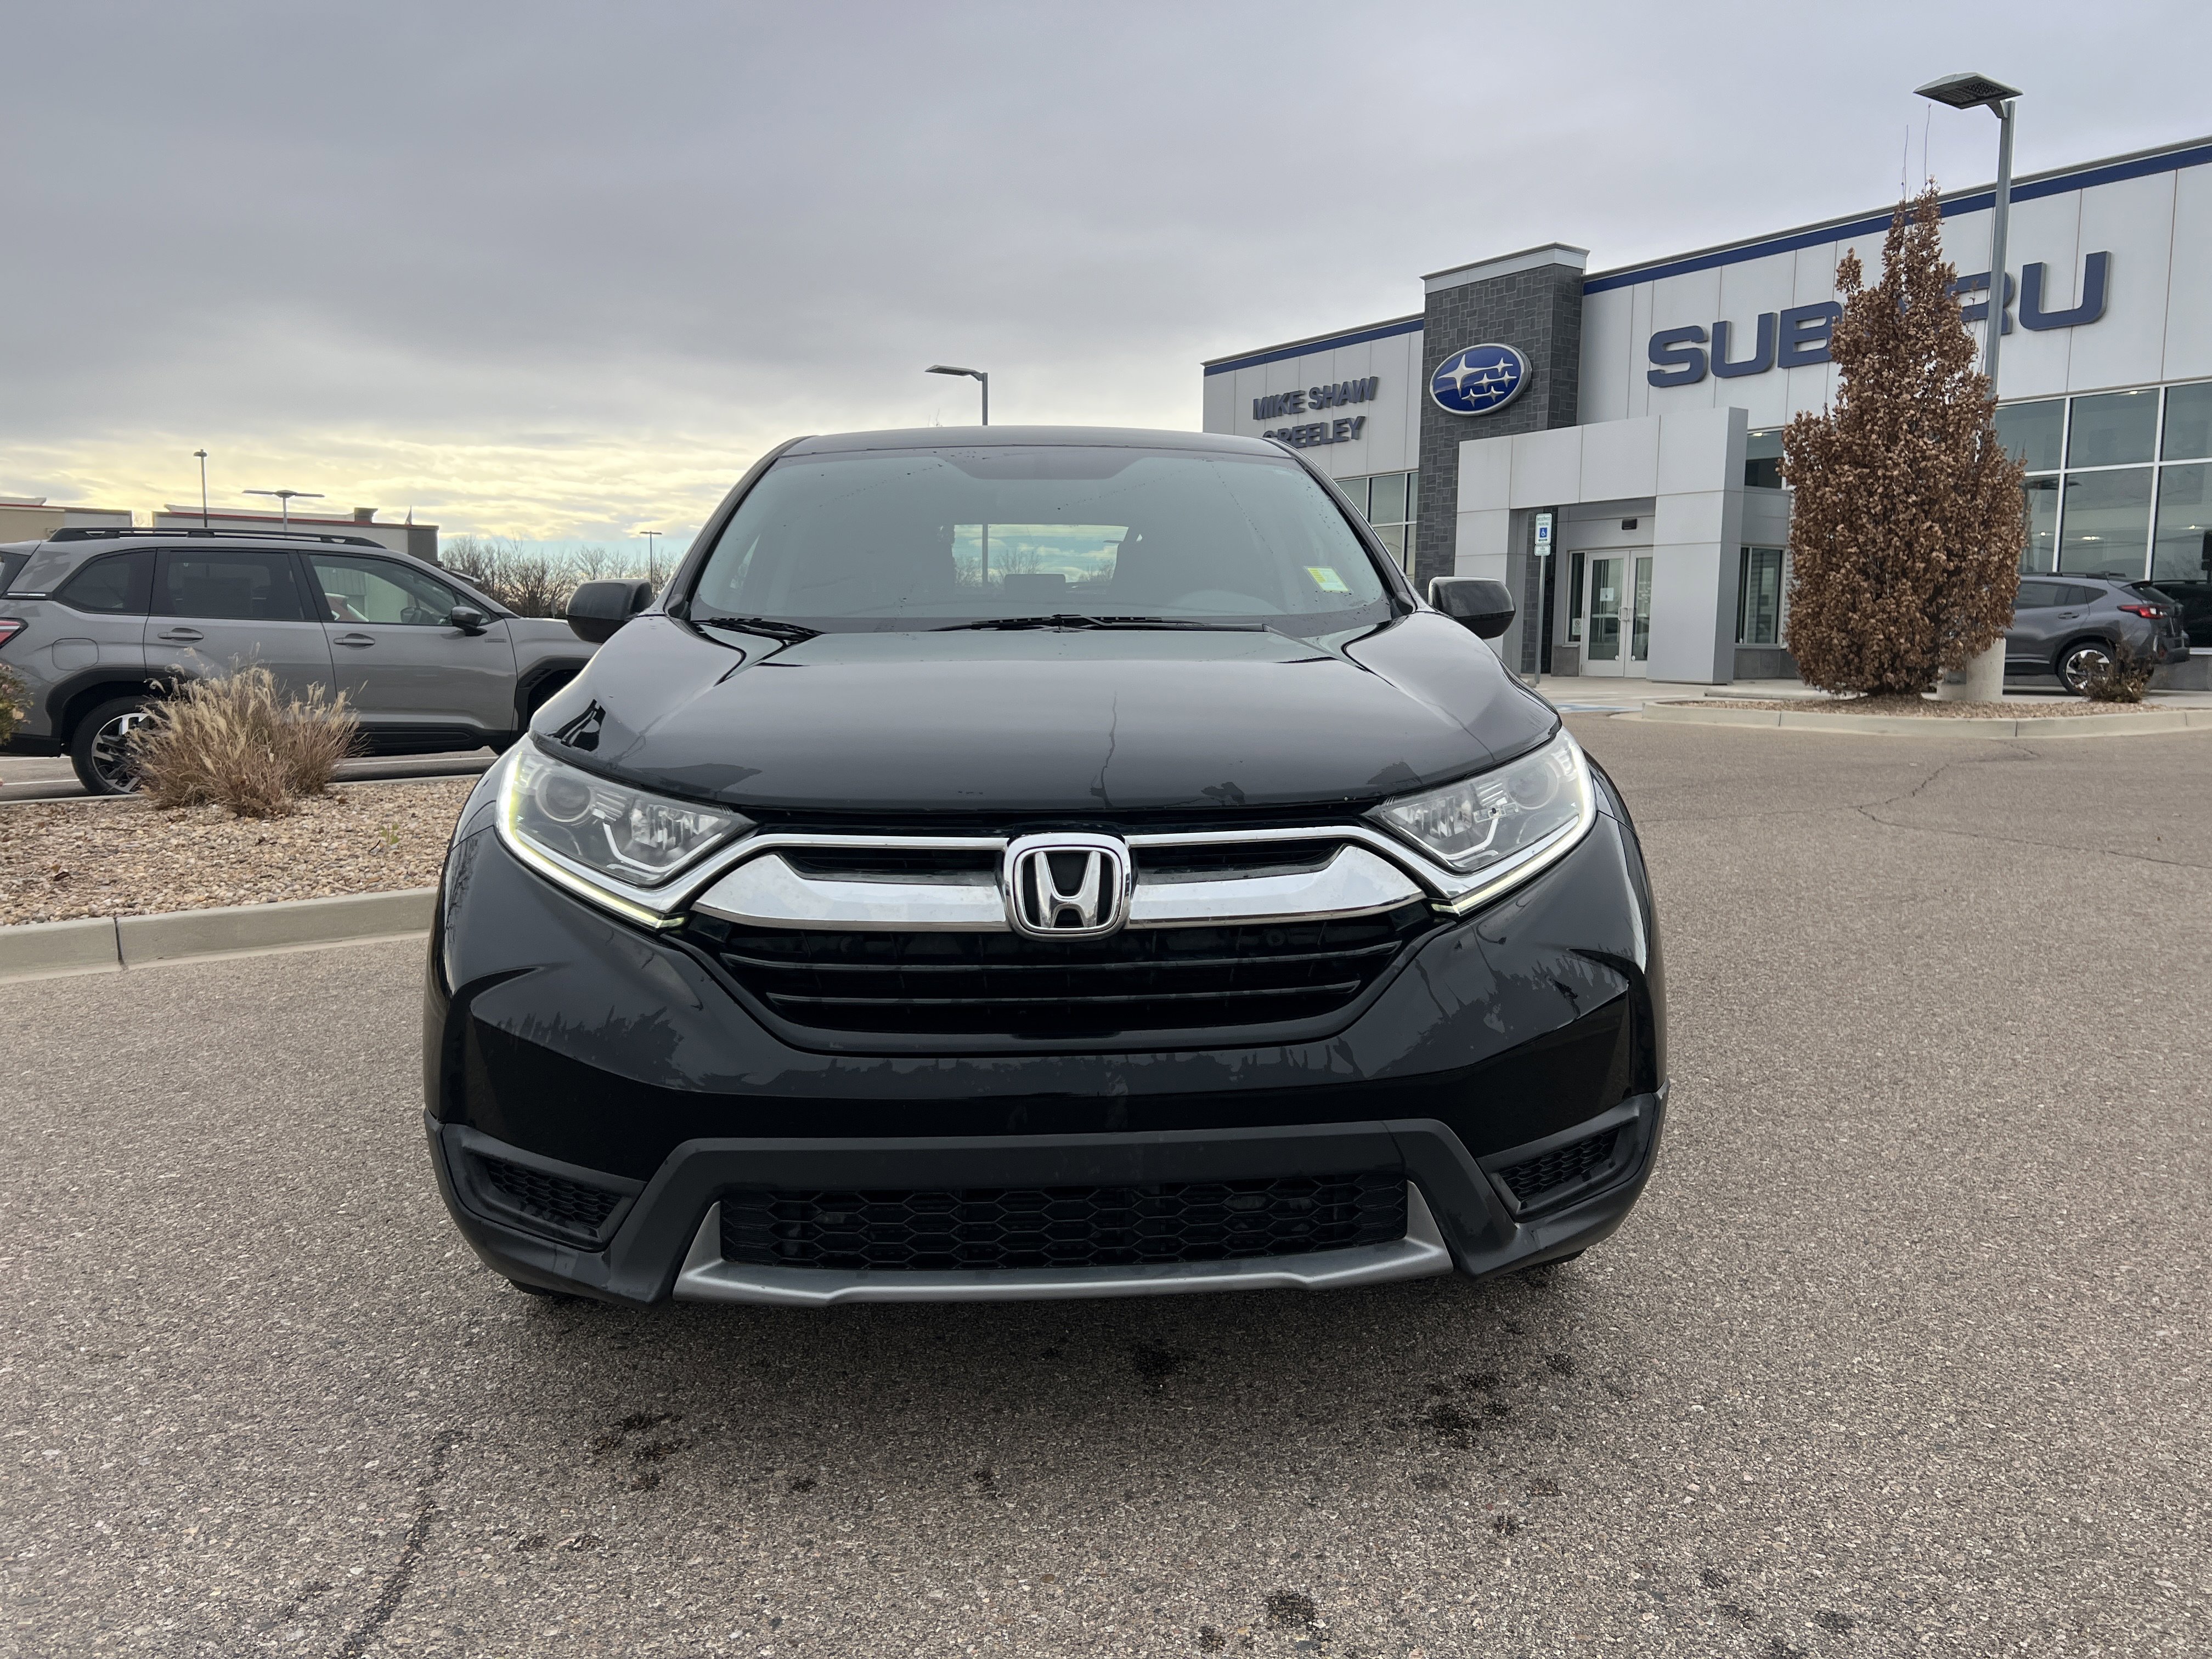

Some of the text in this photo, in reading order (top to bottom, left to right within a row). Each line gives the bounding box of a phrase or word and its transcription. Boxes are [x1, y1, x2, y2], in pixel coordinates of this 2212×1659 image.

[1647, 251, 2112, 387] SUBRU
[1253, 376, 1378, 420] MIKE SHAW
